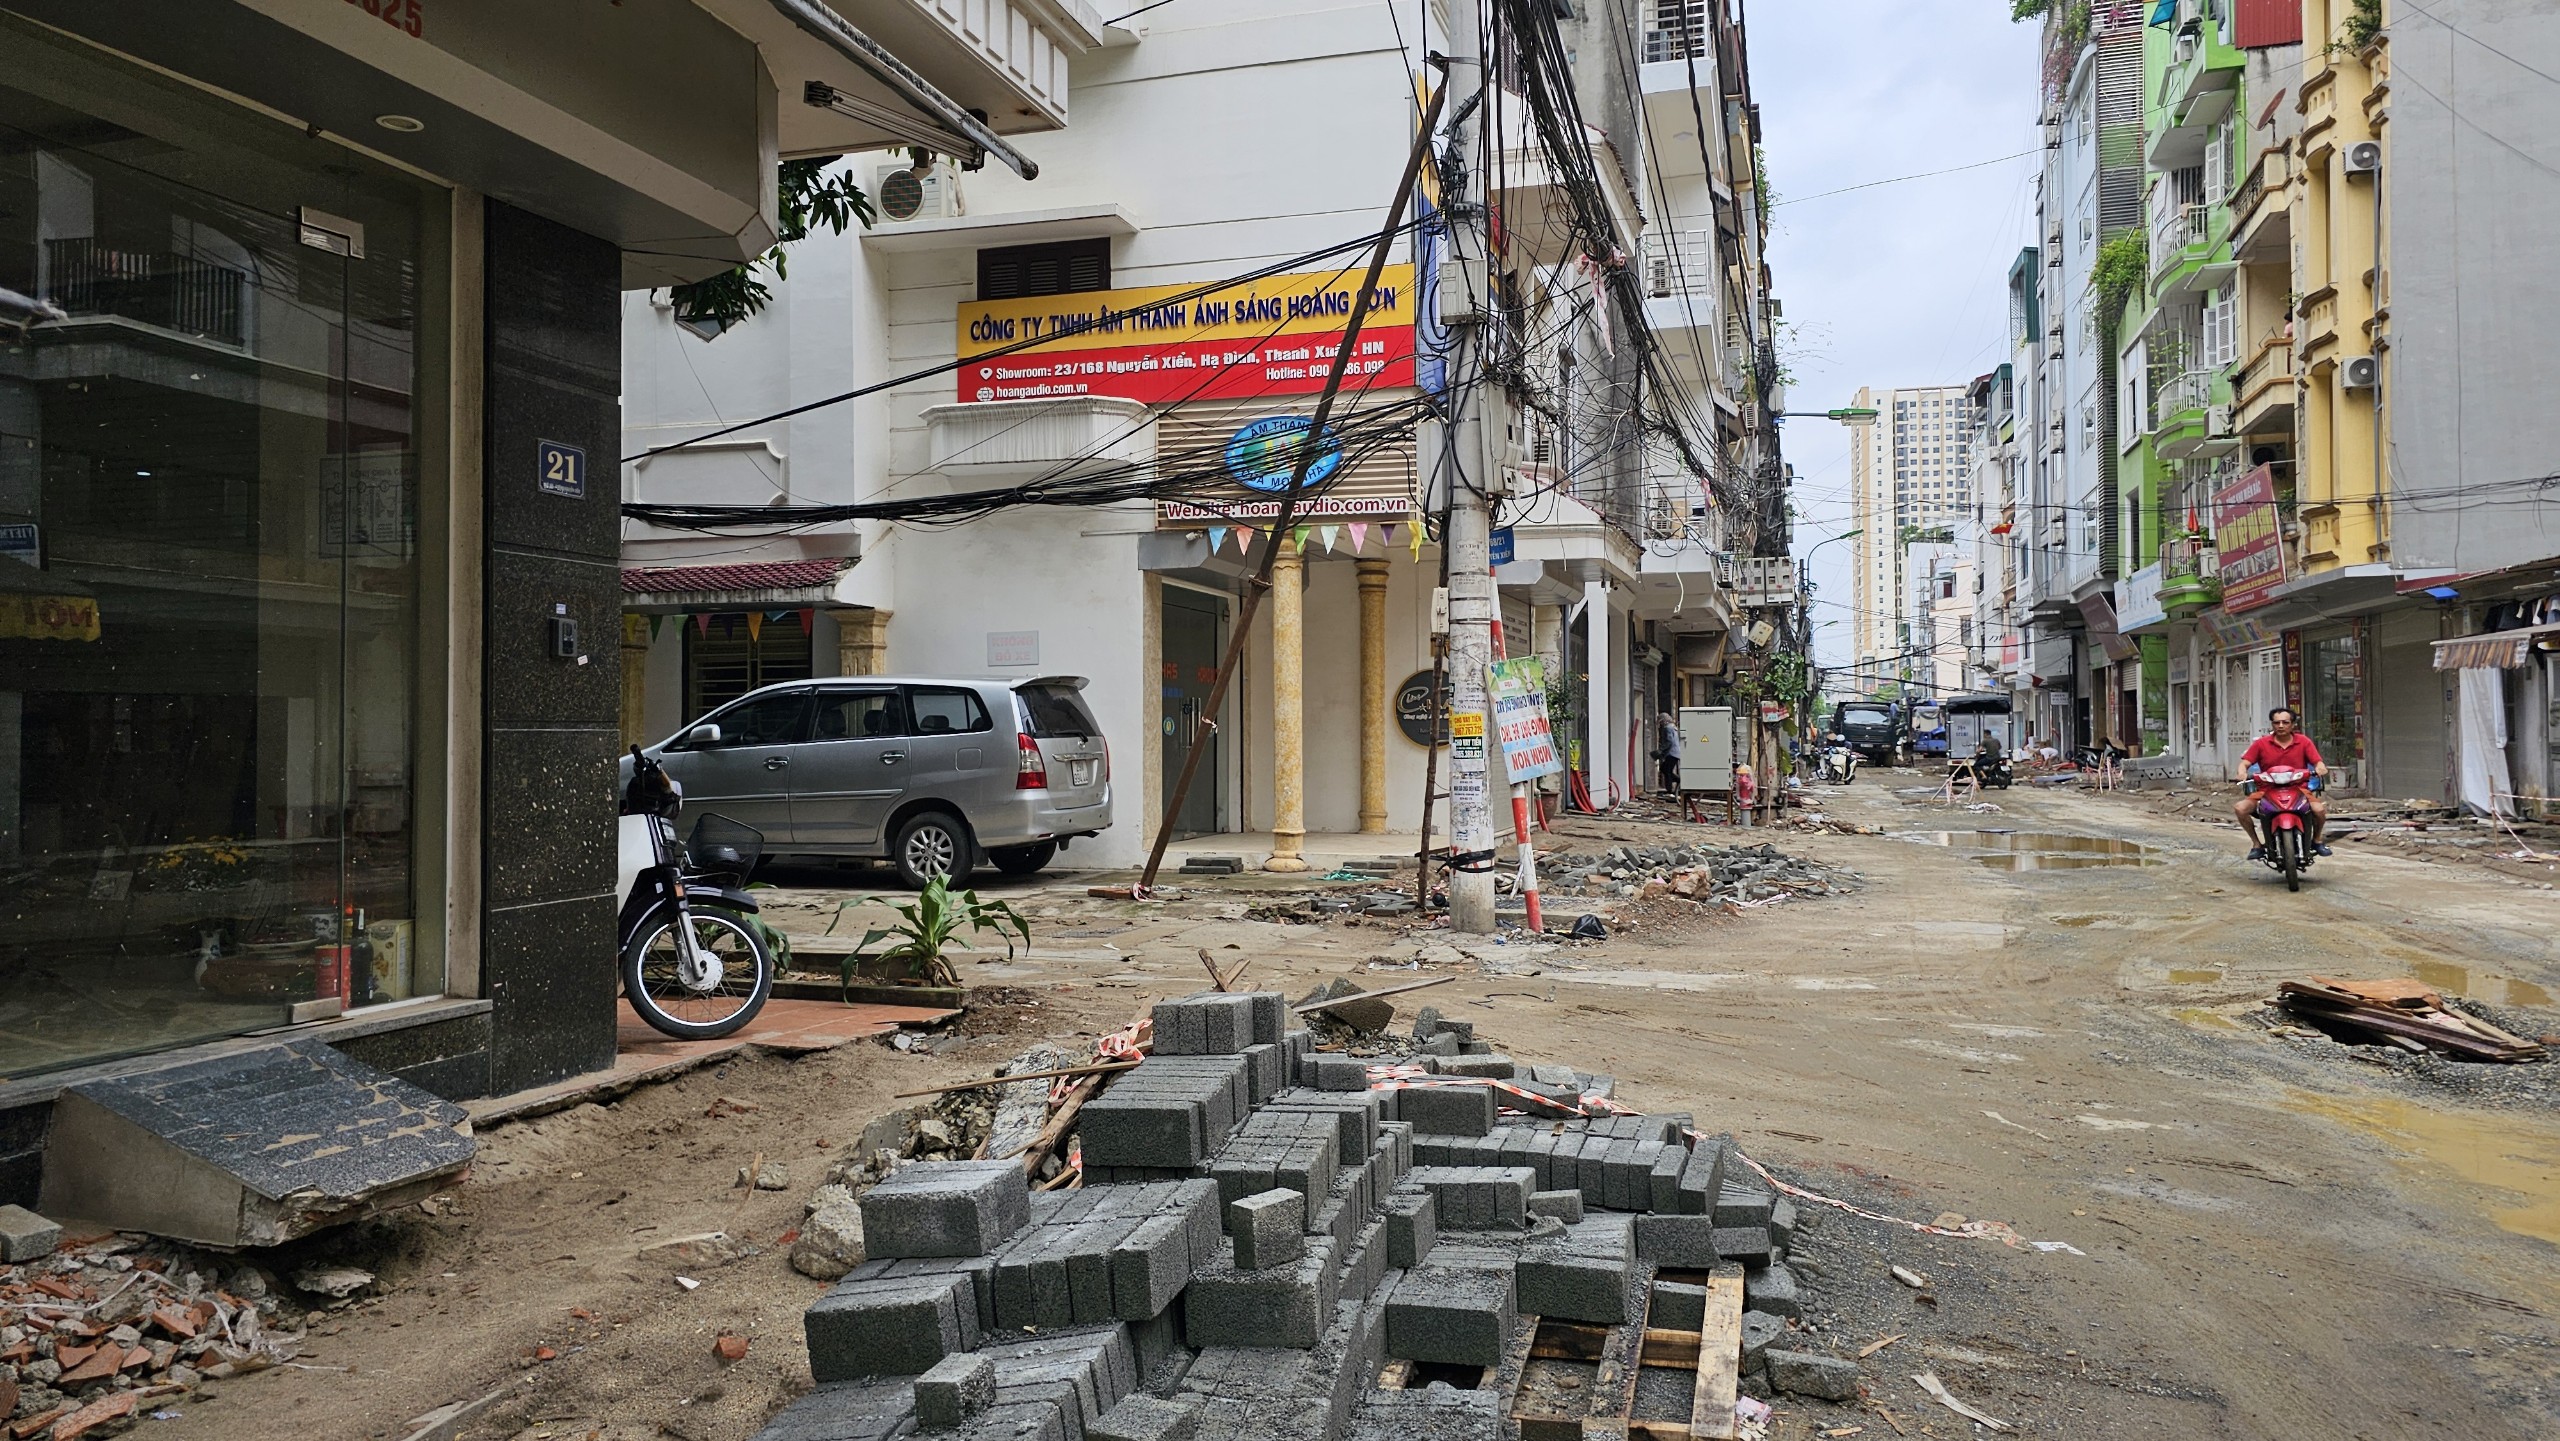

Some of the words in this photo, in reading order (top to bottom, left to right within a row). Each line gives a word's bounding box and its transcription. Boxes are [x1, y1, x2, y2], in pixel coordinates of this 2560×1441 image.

[345, 0, 422, 38] 25
[970, 313, 1015, 341] CÔNG
[1021, 317, 1043, 337] TY
[1049, 313, 1092, 335] TNHH
[1098, 304, 1123, 332] ÂM
[1132, 304, 1186, 331] THANH
[1235, 293, 1281, 323] SÁNG
[1288, 287, 1349, 317] HOÀNG
[996, 368, 1052, 380] Showroom:
[1054, 361, 1104, 376] 23/168
[1106, 354, 1158, 375] Nguyễn
[1162, 351, 1197, 369] Xiển,
[1201, 353, 1219, 369] Hạ
[1223, 350, 1260, 366] Đình,
[1264, 346, 1309, 363] Thanh
[1315, 343, 1357, 360] Xuâ,
[1362, 341, 1384, 354] HN
[1266, 368, 1306, 380] Hotline:
[996, 382, 1088, 400] hoangaudio.com.vn
[547, 451, 577, 484] 21
[1167, 501, 1236, 518] Website:
[1240, 497, 1407, 516] hoanaudio.com.vn
[1490, 536, 1505, 547] 68/21
[1511, 751, 1531, 771] NON
